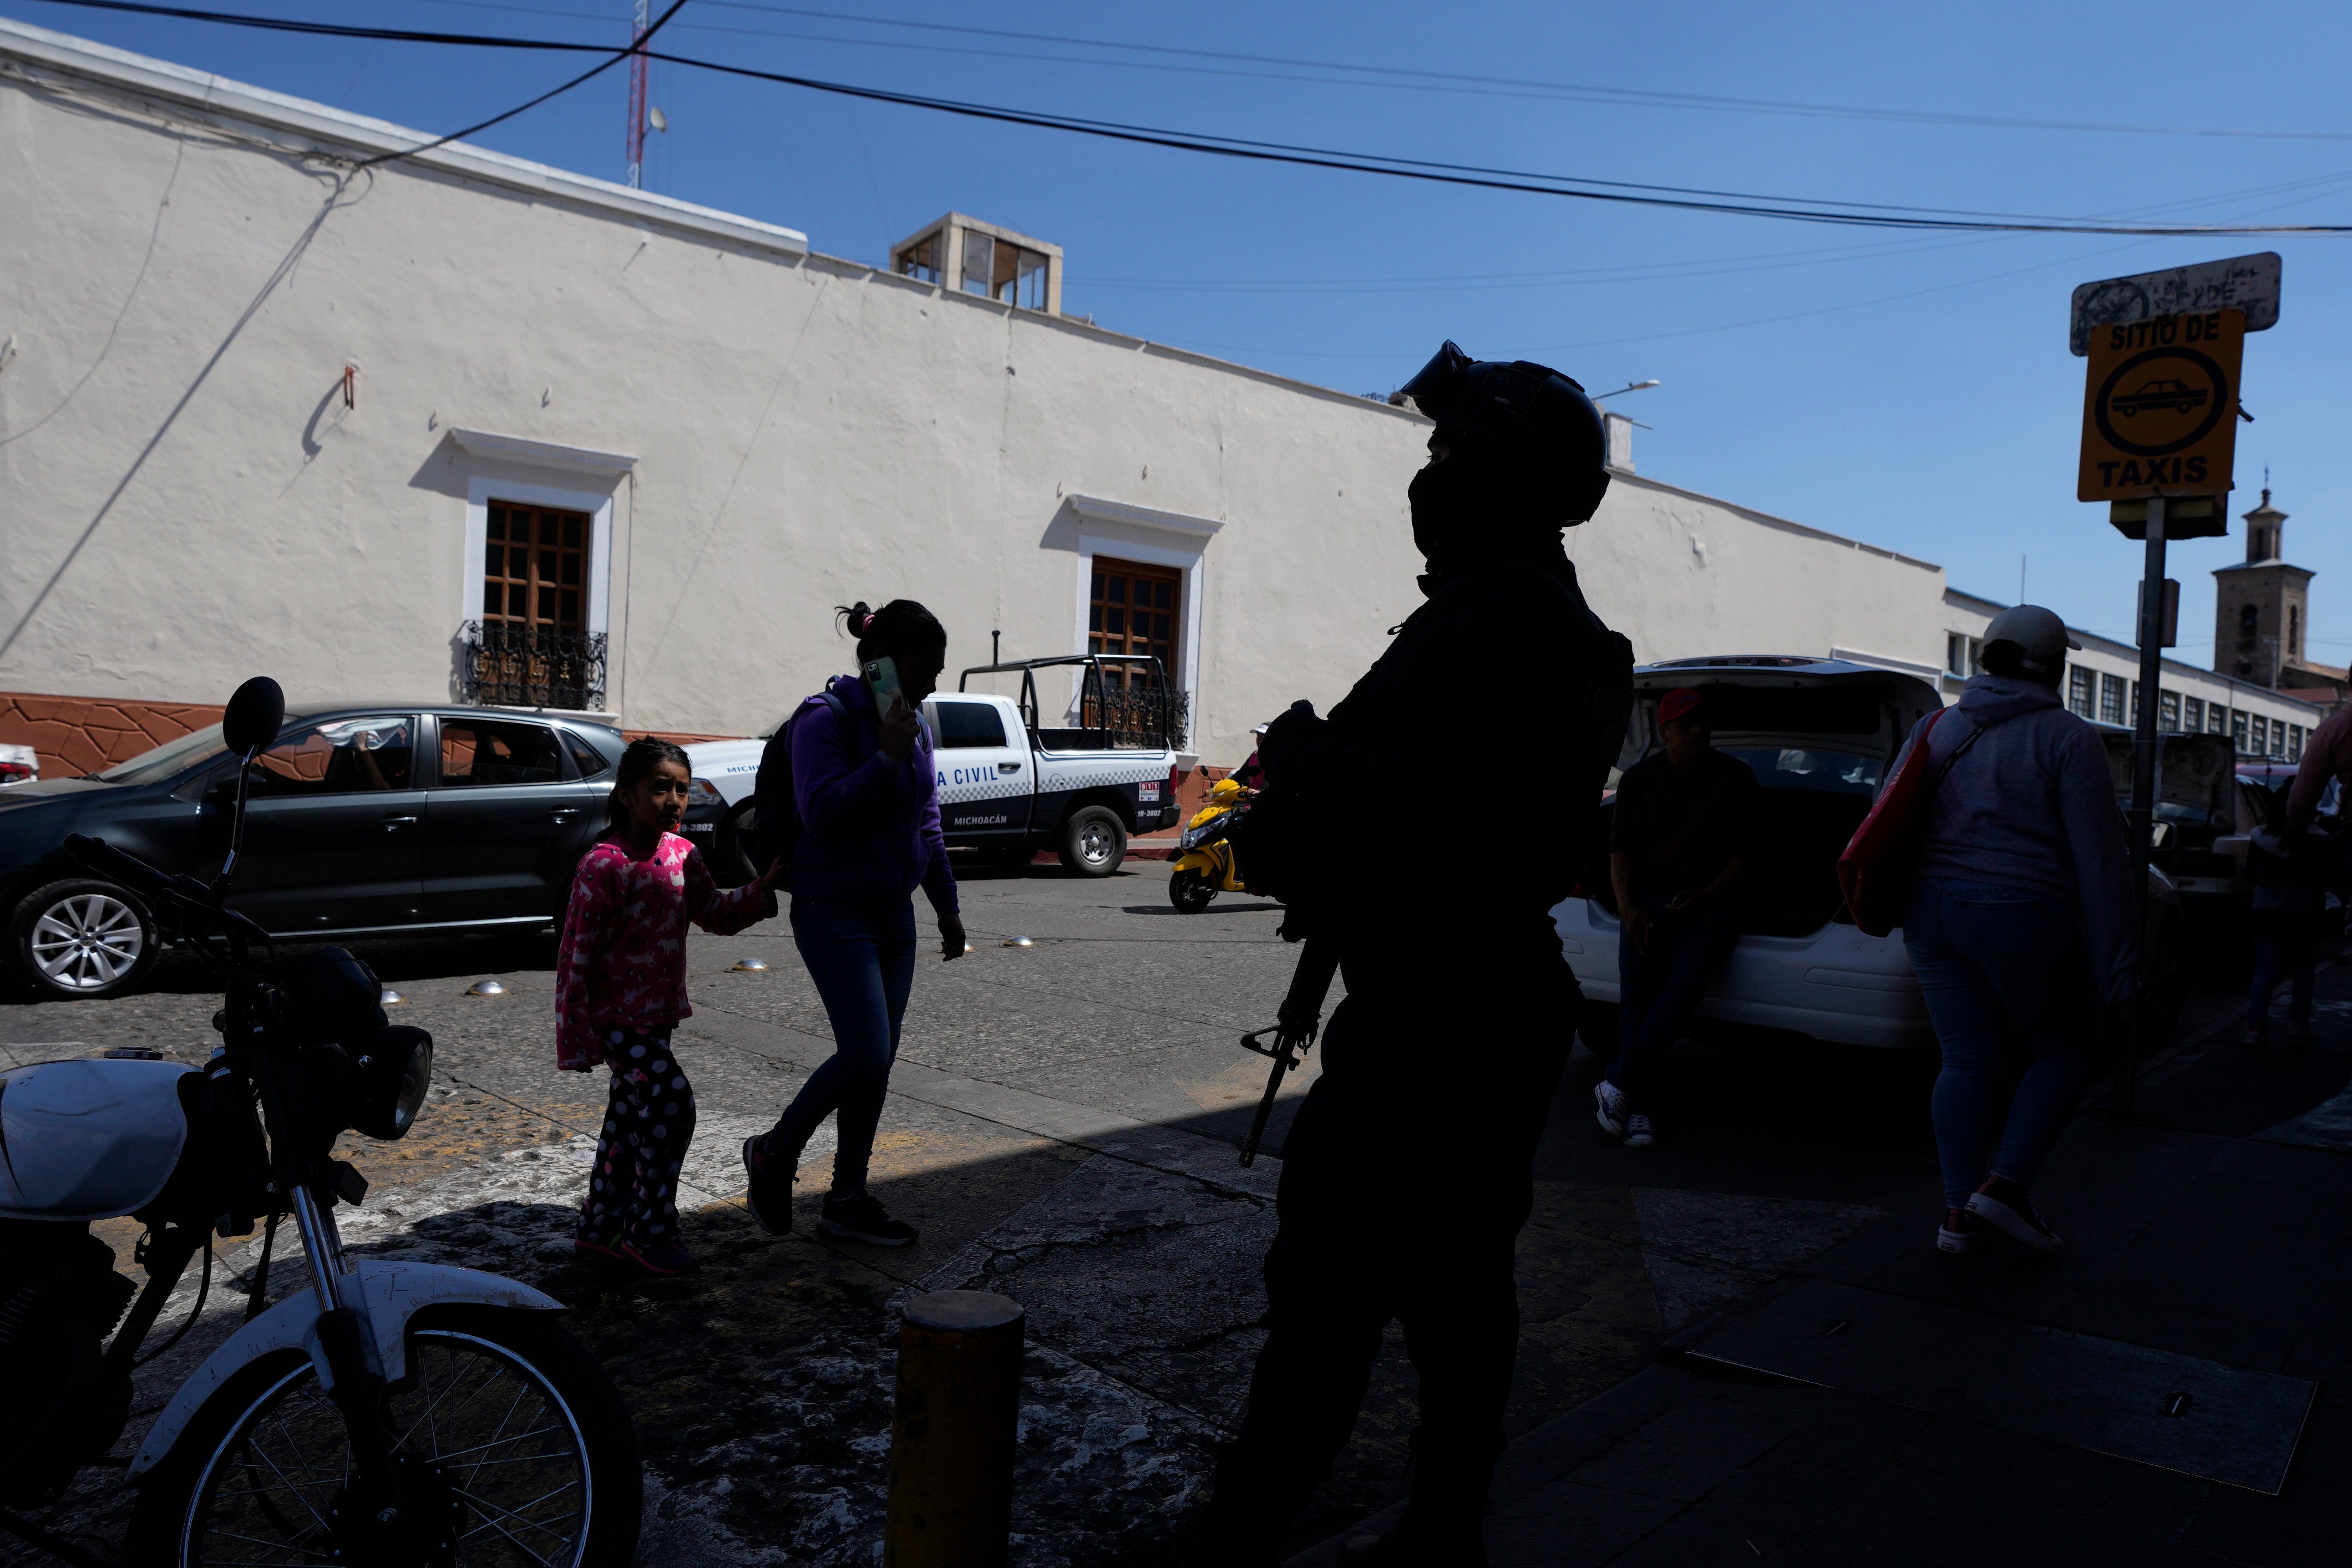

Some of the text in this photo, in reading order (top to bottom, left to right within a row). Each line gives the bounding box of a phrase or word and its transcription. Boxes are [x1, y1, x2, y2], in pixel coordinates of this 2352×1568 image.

[2110, 313, 2221, 350] SITIO DE
[2097, 456, 2208, 488] TAXIS
[954, 766, 997, 785] CIVIL
[681, 823, 714, 832] 9-3802
[954, 813, 1007, 826] MICHOACÁN
